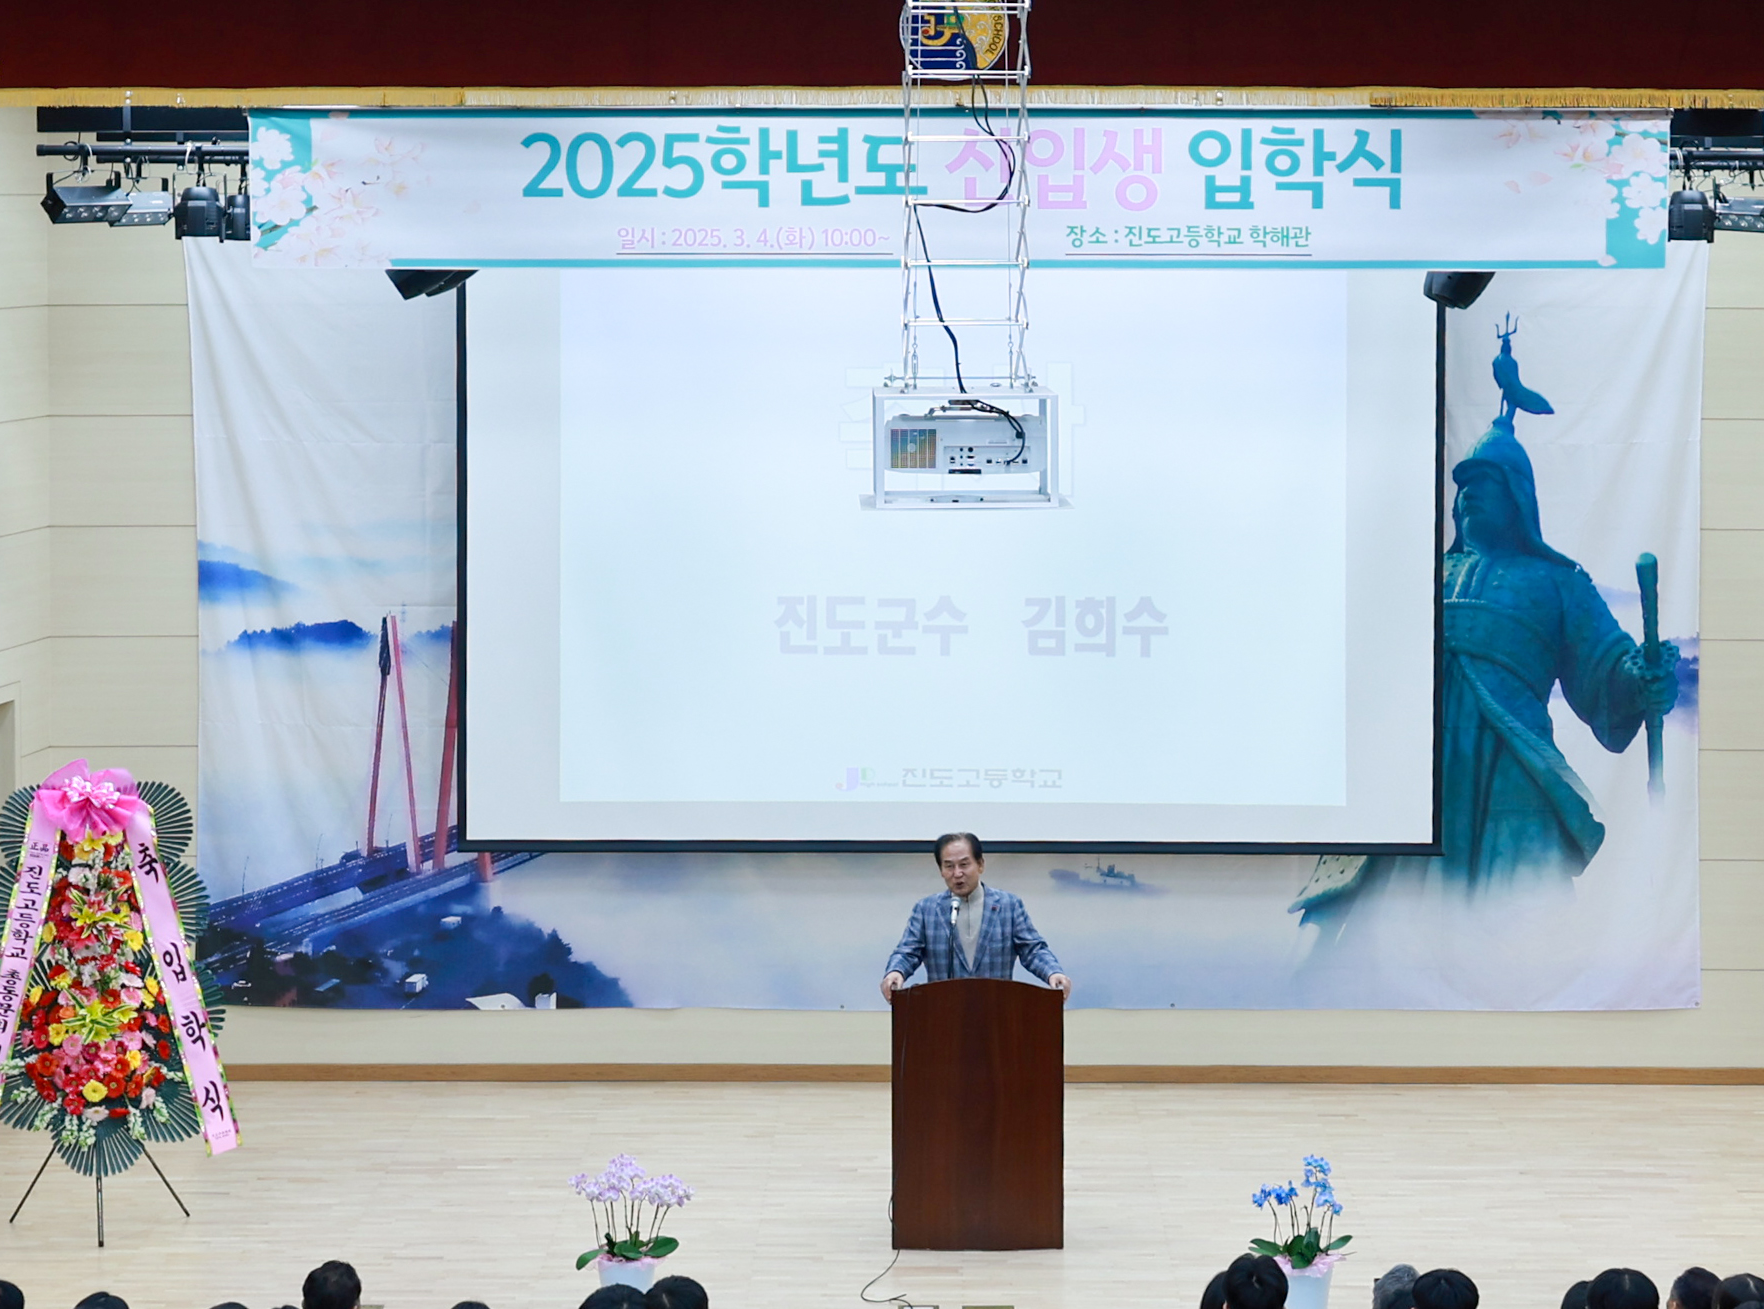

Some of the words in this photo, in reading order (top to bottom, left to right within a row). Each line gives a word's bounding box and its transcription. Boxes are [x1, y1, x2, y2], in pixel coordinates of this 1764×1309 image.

[983, 15, 1004, 56] SCHOOL
[520, 123, 928, 208] 2025학년도
[945, 126, 1162, 212] 신입생
[1187, 126, 1403, 212] 입학식
[617, 226, 656, 250] 일시
[671, 228, 727, 248] 2025.
[733, 228, 751, 248] 3.
[822, 228, 891, 247] 10:00~
[1066, 225, 1108, 249] 장소
[1124, 225, 1244, 249] 진도고등학교
[1249, 225, 1312, 248] 학해관
[774, 594, 969, 657] 진도군수
[1021, 595, 1169, 658] 김희수
[901, 767, 1063, 789] 진도고등학교
[4, 864, 43, 960] 진도고등학교
[137, 843, 159, 883] 축
[162, 942, 224, 1121] 입학식
